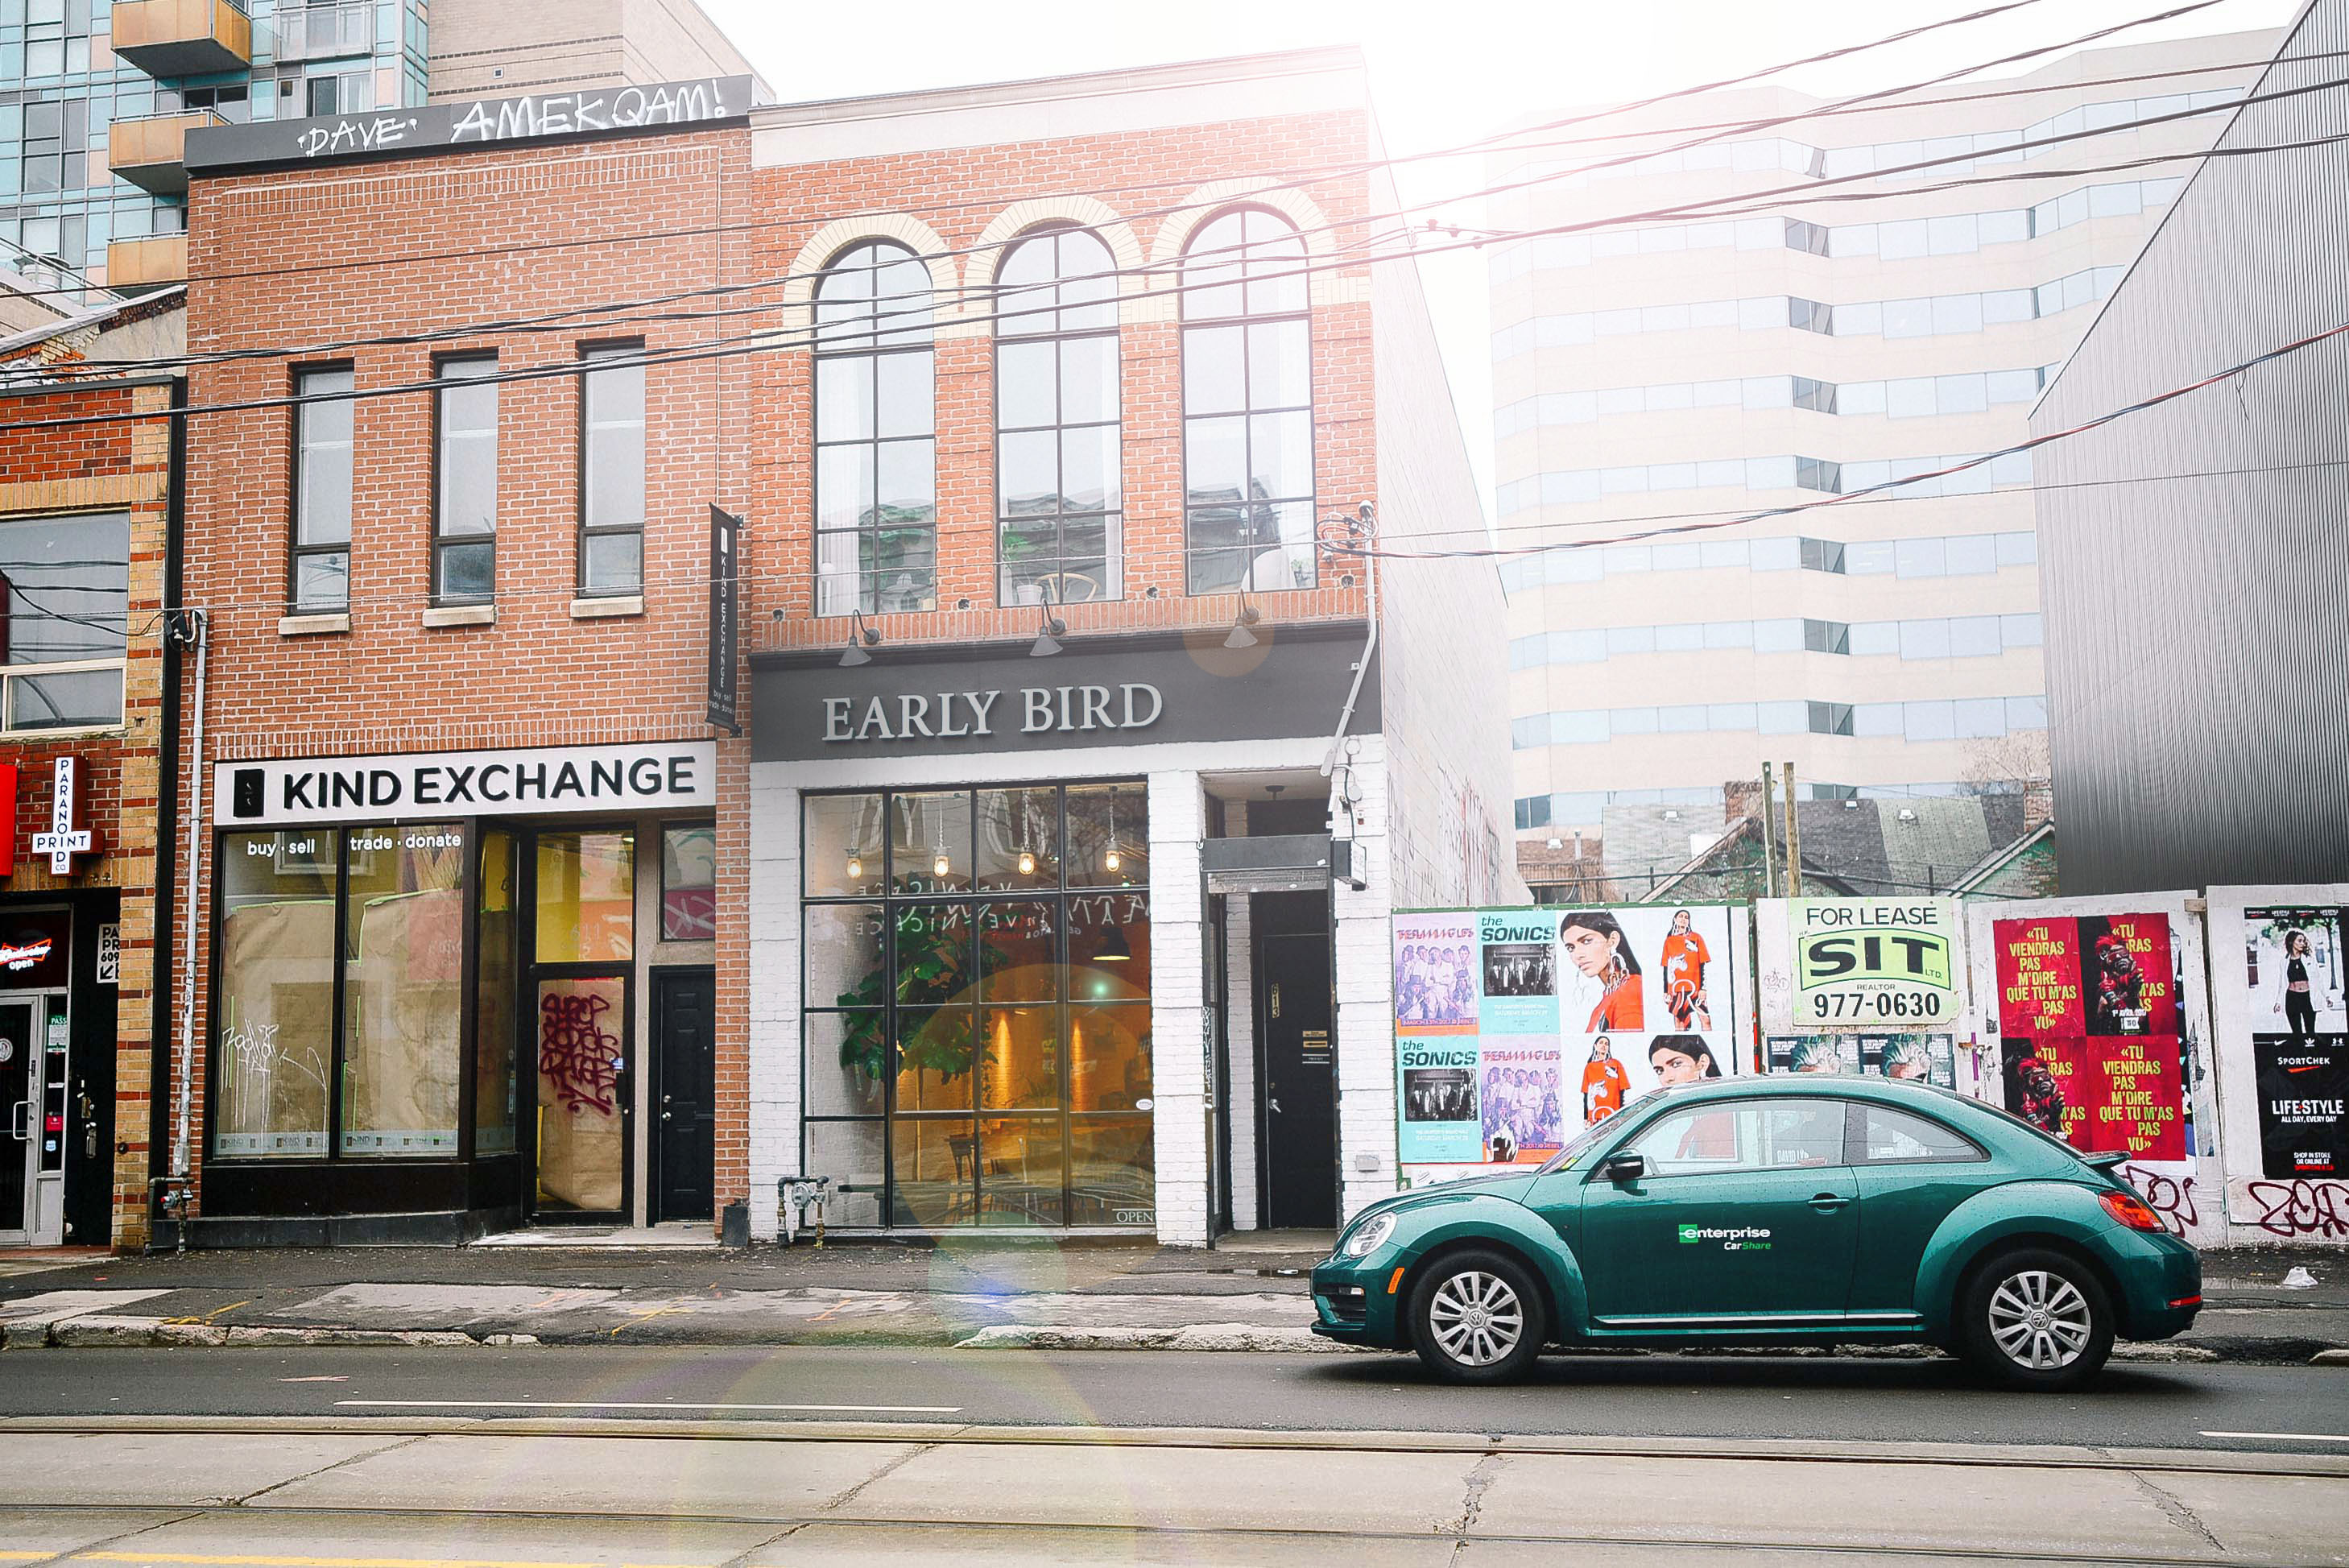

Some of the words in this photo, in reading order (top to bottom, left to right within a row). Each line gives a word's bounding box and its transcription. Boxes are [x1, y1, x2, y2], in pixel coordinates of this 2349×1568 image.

[821, 689, 1001, 743] EARLY
[1020, 682, 1163, 734] BIRD
[283, 769, 403, 809] KIND
[413, 755, 696, 805] EXCHANGE
[57, 759, 69, 863] PARANOID
[37, 834, 87, 849] PRINT
[246, 841, 276, 858] buy
[287, 838, 316, 854] sell
[349, 835, 394, 852] trade
[404, 832, 461, 850] donate
[1481, 915, 1503, 926] the
[1806, 907, 1853, 925] FOR
[1860, 907, 1938, 925] LEASE
[1481, 926, 1556, 942] SONICS
[2008, 941, 2065, 957] VIENDRAS
[9, 959, 34, 970] open
[1808, 936, 1940, 977] SIT
[1925, 968, 1942, 978] LTD.
[2019, 957, 2041, 971] PAS
[2017, 971, 2057, 987] M'DIRE
[2006, 986, 2029, 1003] QUE
[2031, 986, 2046, 1000] TU
[2048, 984, 2077, 999] M'AS
[1813, 992, 1941, 1018] 977-0630
[2042, 1000, 2066, 1015] PAS
[52, 1017, 67, 1025] PASS
[1402, 1040, 1424, 1051] the
[1401, 1051, 1477, 1066] SONICS
[2103, 1060, 2161, 1075] VIENDRAS
[2113, 1076, 2136, 1090] PAS
[2111, 1090, 2153, 1106] M'DIRE
[2099, 1106, 2124, 1123] QUE
[2127, 1106, 2141, 1120] TU
[2144, 1106, 2174, 1121] M'AS
[2292, 1115, 2306, 1124] DAY,
[2138, 1122, 2161, 1136] PAS
[1116, 1211, 1154, 1223] OPEN
[1679, 1226, 1771, 1240] enterprise
